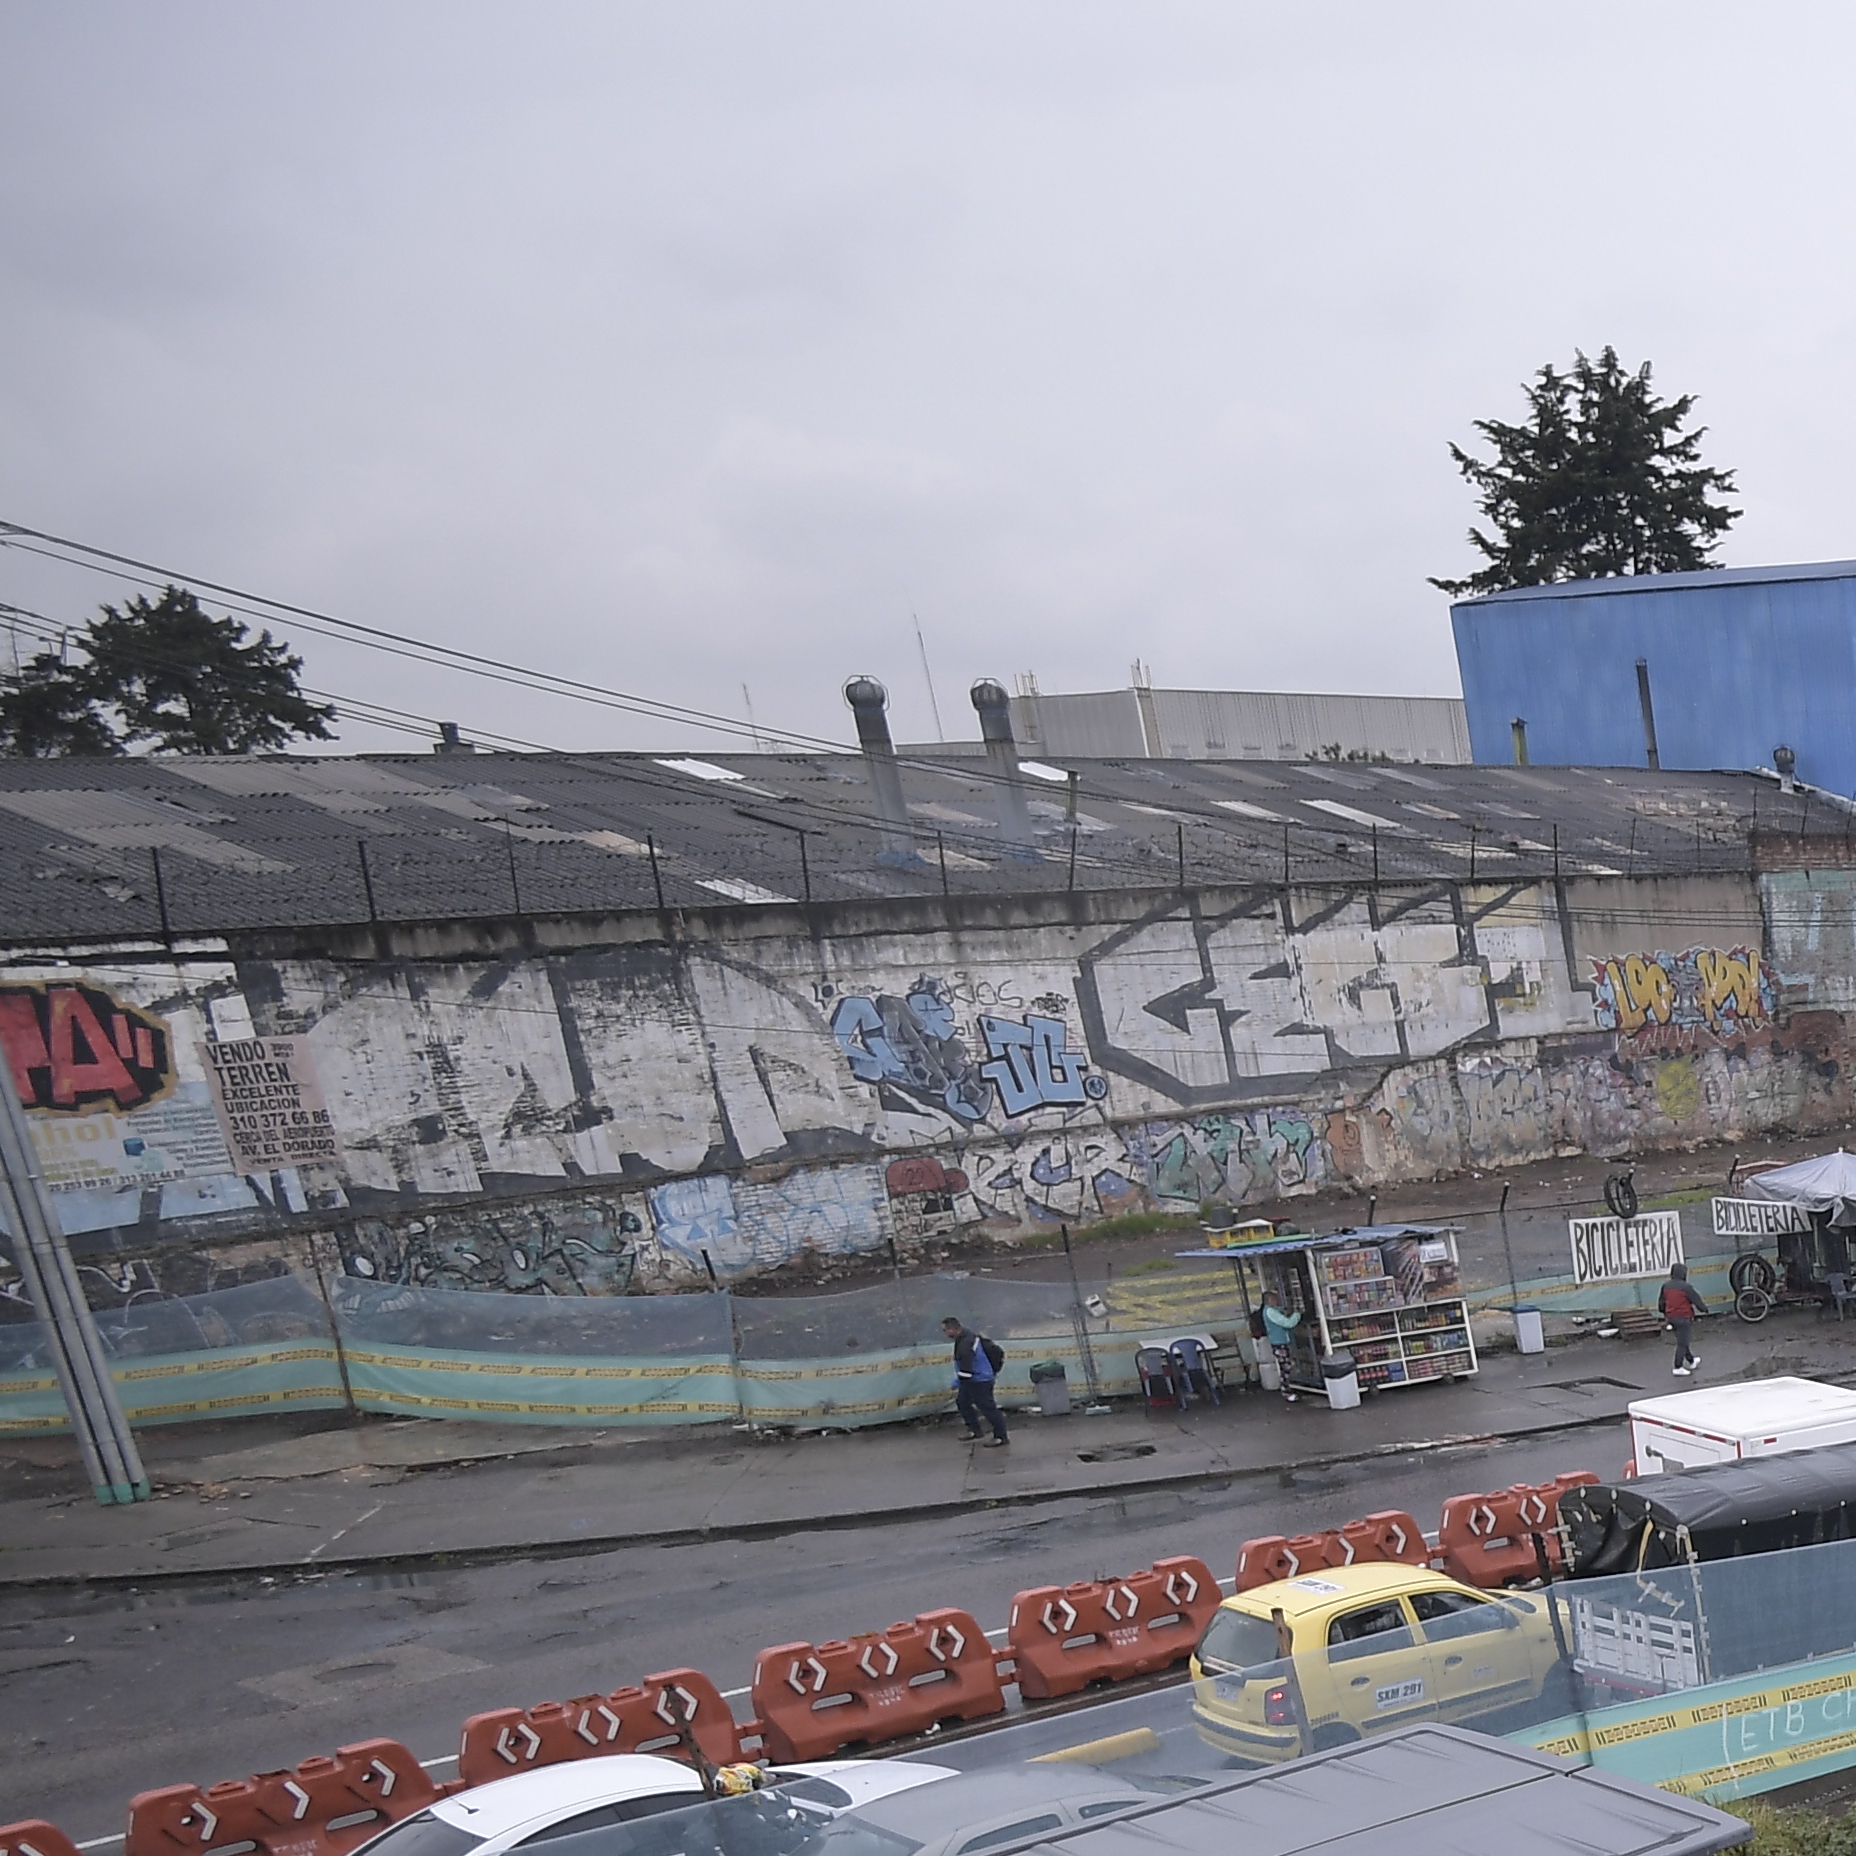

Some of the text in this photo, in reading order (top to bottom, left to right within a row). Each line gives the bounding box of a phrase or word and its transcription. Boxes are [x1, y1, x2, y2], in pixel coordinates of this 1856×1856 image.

[205, 1041, 266, 1065] VENDO
[222, 1084, 300, 1101] EXCELENTE
[224, 1098, 301, 1113] UBICACION
[230, 1115, 257, 1130] 310
[261, 1113, 288, 1128] 372
[264, 1142, 279, 1154] EL
[283, 1139, 335, 1152] DORADO
[1574, 1219, 1682, 1282] BICICLETERIA
